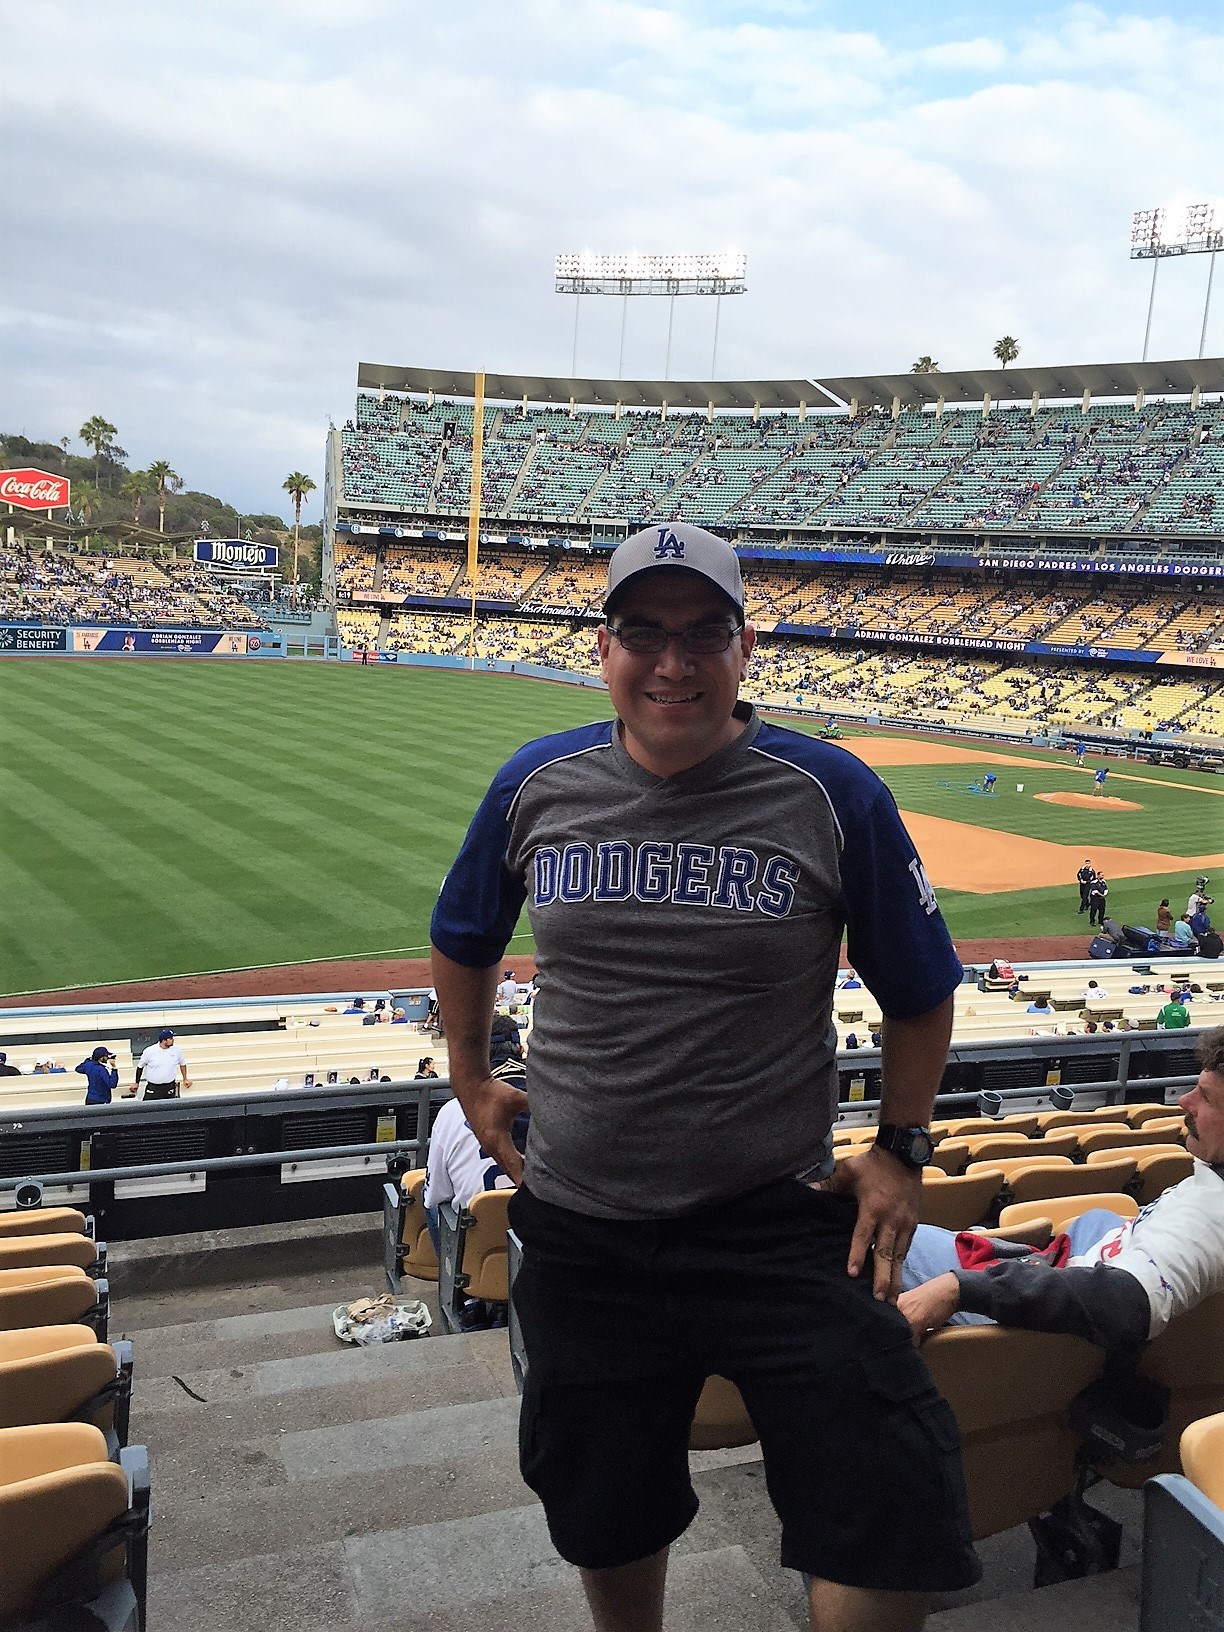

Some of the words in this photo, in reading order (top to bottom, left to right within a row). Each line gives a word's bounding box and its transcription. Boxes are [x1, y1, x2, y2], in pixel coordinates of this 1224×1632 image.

[1, 476, 63, 501] Coca-Cola
[400, 505, 462, 516] DODGER
[484, 512, 543, 522] TADIUM
[556, 516, 591, 524] CLUB
[211, 541, 266, 565] Montejo
[654, 528, 685, 559] LA
[979, 559, 998, 567] SAN
[1003, 560, 1034, 569] DIEGO
[1039, 561, 1077, 570] PADRES
[1095, 562, 1115, 571] LOS
[1120, 563, 1169, 574] ANGELES
[17, 629, 61, 639] SECURITY
[854, 630, 886, 641] ADRIAN
[889, 633, 934, 644] GONZALEZ
[936, 636, 993, 648] BOBBLEHEAD
[996, 641, 1026, 651] NIGHT
[1186, 655, 1195, 664] WE
[1196, 656, 1209, 666] LOVE
[534, 840, 800, 919] DODGERS
